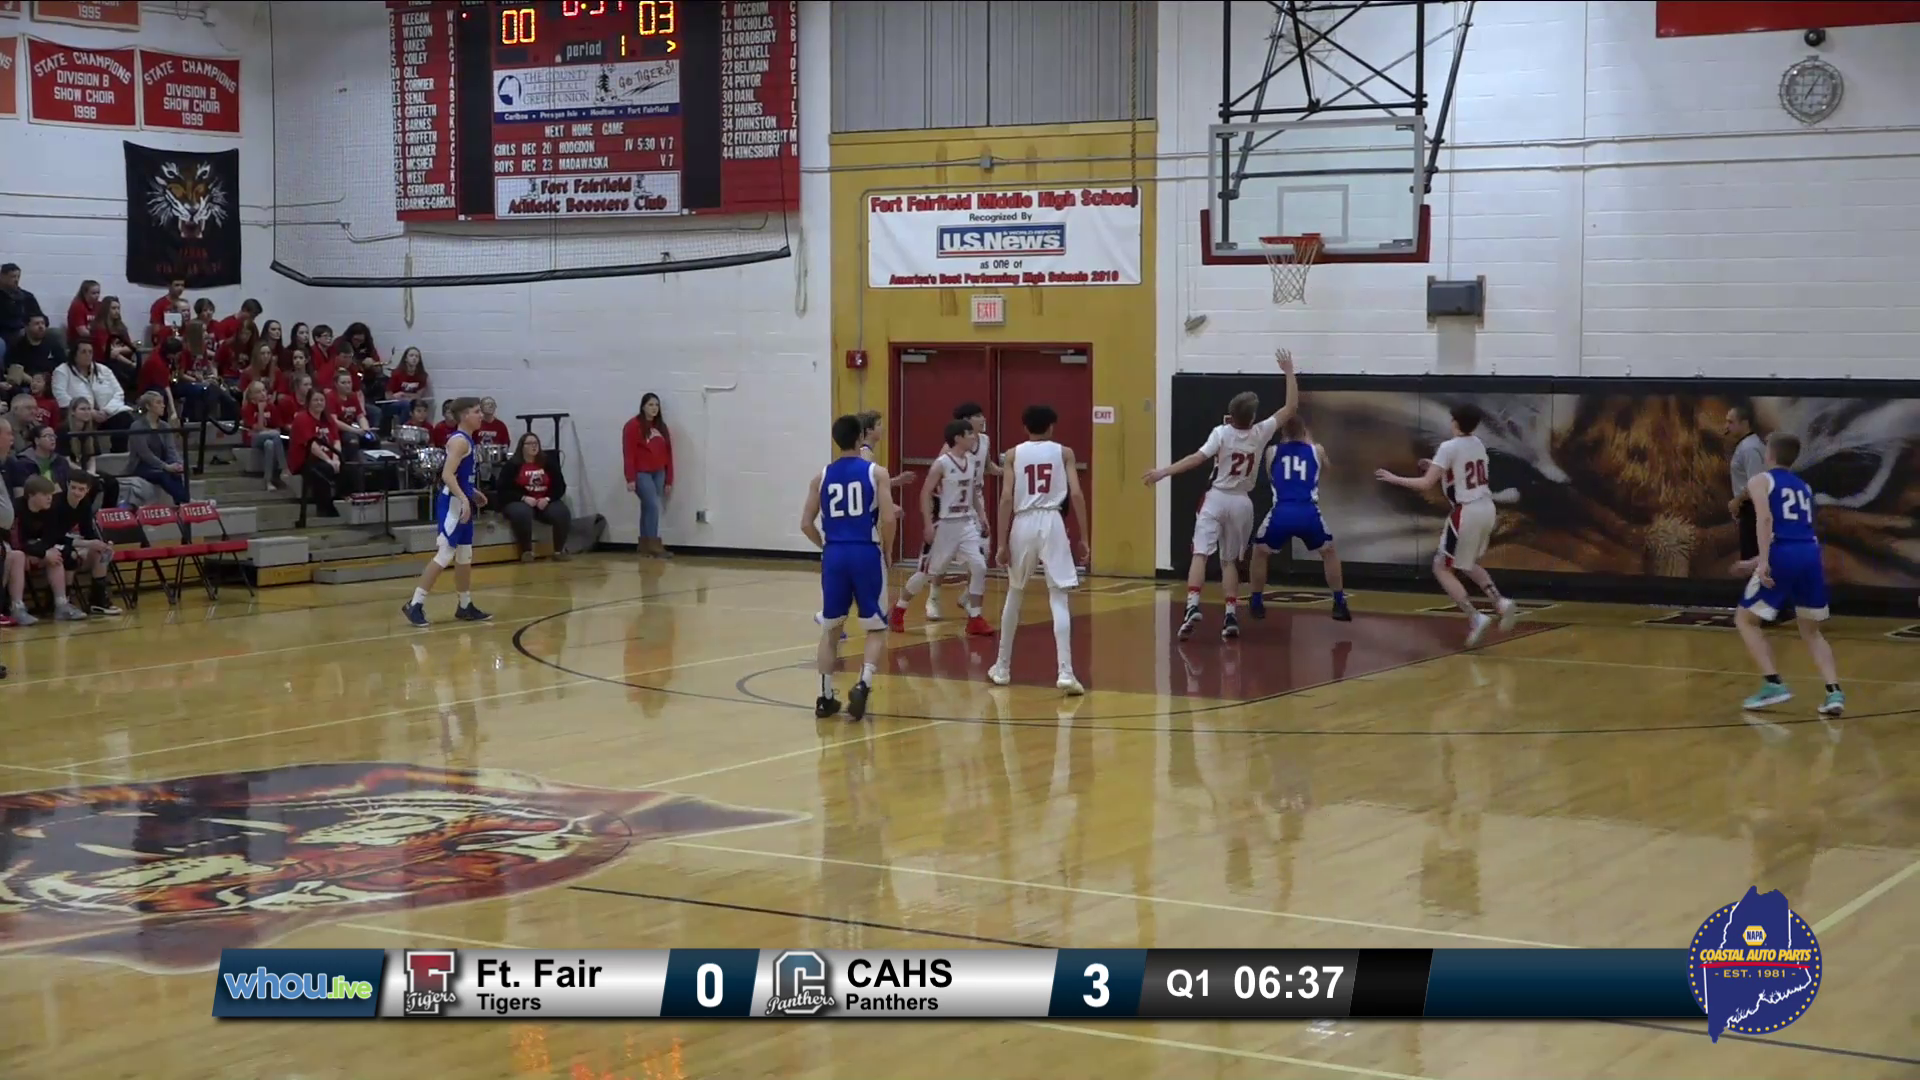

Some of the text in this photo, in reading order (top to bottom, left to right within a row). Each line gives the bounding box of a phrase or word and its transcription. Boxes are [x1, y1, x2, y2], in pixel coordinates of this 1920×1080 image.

[502, 8, 535, 44] 00
[638, 1, 675, 35] 03
[722, 19, 732, 32] 12
[734, 16, 774, 31] NICHOLAS
[403, 25, 433, 38] WATSON
[722, 33, 732, 46] 14
[733, 30, 777, 45] BRADBURY
[722, 45, 770, 61] 20 CARVELL
[34, 53, 68, 77] STATE
[73, 51, 131, 85] CHAMPIONS
[722, 61, 733, 75] 22
[57, 70, 109, 88] DIVISION B
[144, 60, 237, 94] STATE CHAMPIONS
[722, 75, 734, 89] 24
[734, 74, 762, 88] PRYOR
[54, 87, 115, 104] SHOW CHOIR
[166, 83, 216, 99] DIVISION B
[722, 89, 756, 103] 30 DAHL
[163, 97, 220, 114] SHOW CHOIR
[722, 104, 733, 117] 32
[734, 102, 763, 116] HAINES
[405, 118, 432, 131] BARNES
[545, 122, 624, 138] NEXT HOME GAME
[722, 117, 733, 131] 34
[735, 116, 777, 130] JOHNSTON
[722, 132, 733, 145] 42
[494, 144, 516, 156] GIRLS
[522, 143, 537, 156] DEC
[542, 142, 552, 154] 20
[637, 138, 655, 150] 5:30
[722, 143, 780, 159] 44 KINGSBURY
[494, 160, 514, 173] BOYS
[522, 159, 537, 172] DEC
[542, 158, 553, 171] 23
[559, 156, 609, 170] MADAWASKA
[407, 171, 426, 183] WEST
[541, 177, 632, 194] Fort Fairfield
[508, 194, 668, 214] Athletic Boosters Club
[870, 196, 903, 213] Fort
[906, 193, 972, 212] Fairfield
[977, 192, 1033, 210] Middle
[1038, 190, 1076, 211] High
[969, 212, 1032, 223] Recognized By
[980, 259, 1022, 269] as one of
[889, 274, 937, 285] America's
[939, 273, 962, 284] Best
[964, 272, 1020, 285] Performing
[1022, 272, 1046, 284] High
[1048, 271, 1088, 282] Schools
[977, 302, 996, 319] EXIT
[1094, 411, 1112, 419] EXIT
[1281, 456, 1307, 481] 14
[1465, 459, 1488, 489] 20
[1024, 463, 1053, 495] 15
[827, 481, 863, 518] 20
[1781, 488, 1812, 523] 24
[102, 511, 130, 523] TIGERS
[142, 507, 171, 519] TIGERS
[184, 504, 213, 516] TIGERS
